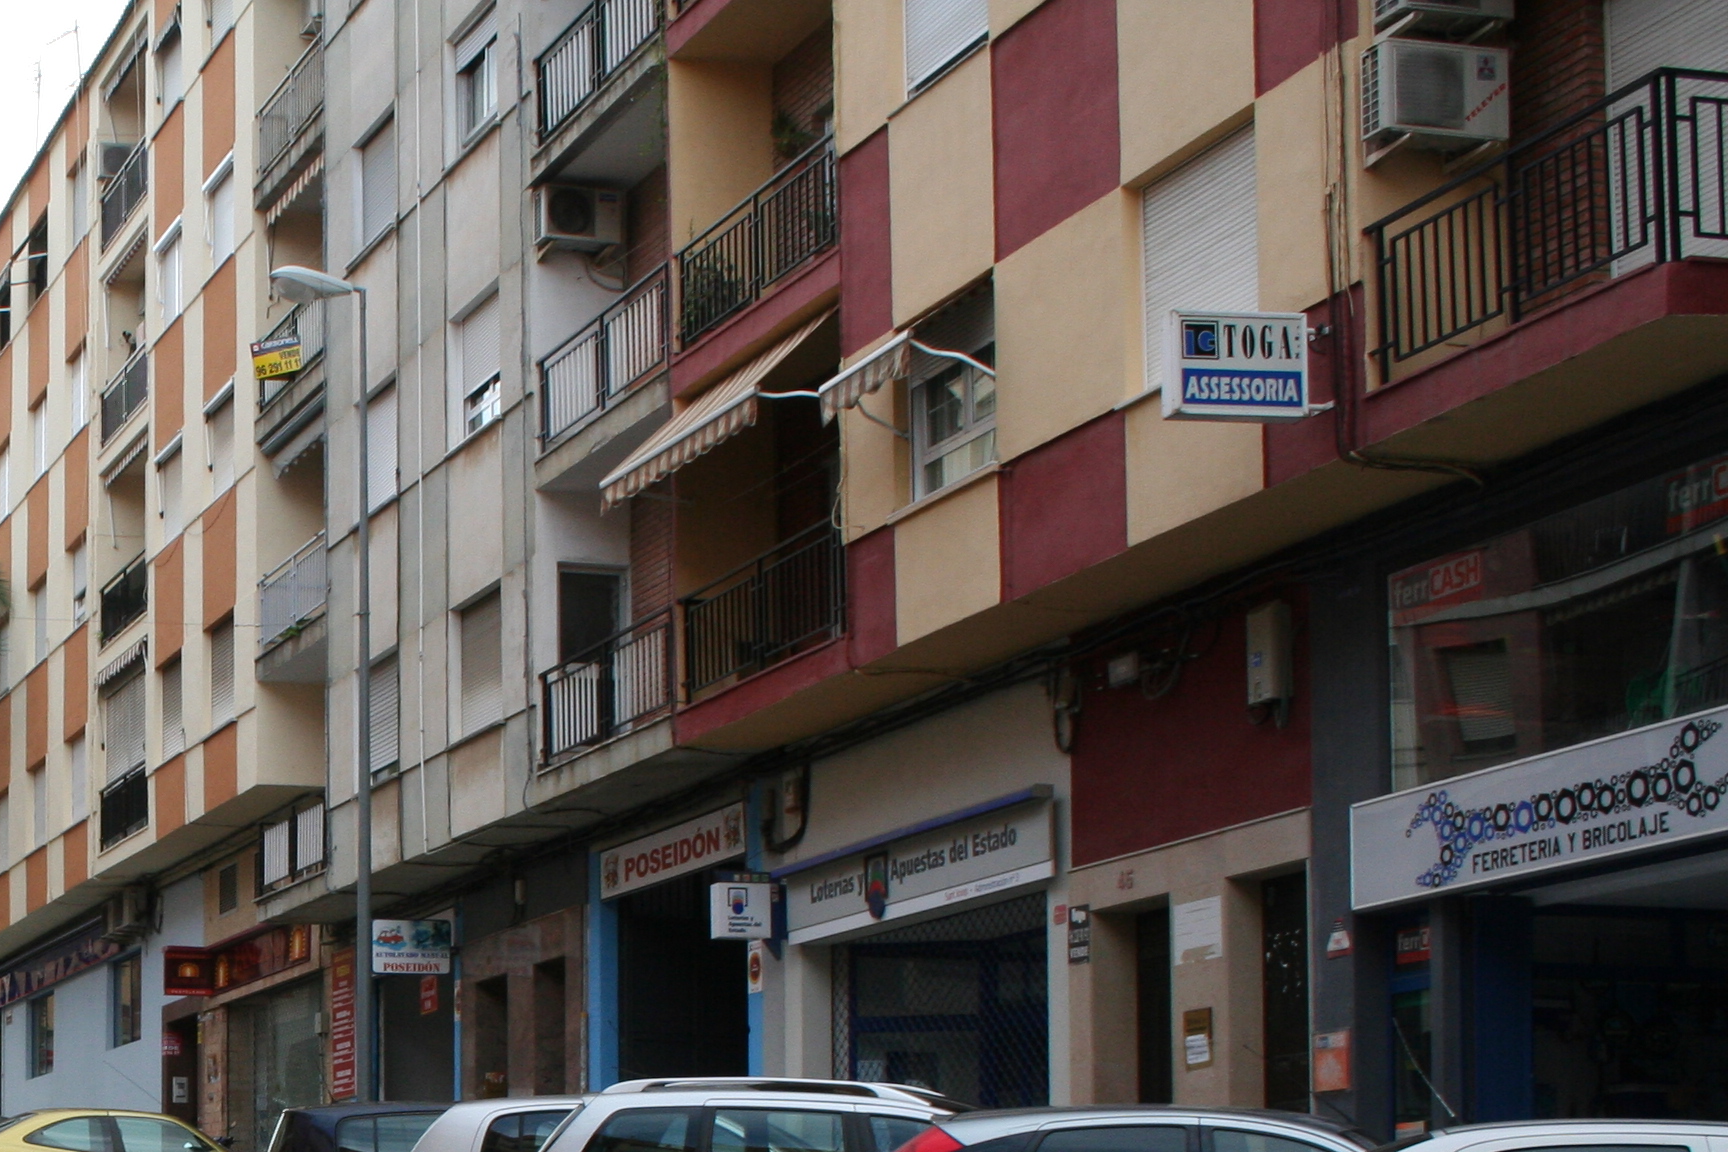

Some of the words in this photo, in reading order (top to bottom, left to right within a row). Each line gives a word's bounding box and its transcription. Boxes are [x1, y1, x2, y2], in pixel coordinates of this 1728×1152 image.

[1223, 324, 1292, 360] TOGA
[256, 364, 267, 377] 96
[1185, 376, 1299, 402] ASSESSORIA
[624, 827, 721, 882] POSEIDÓN
[890, 848, 946, 885] Apuestas
[949, 835, 969, 864] del
[972, 824, 1017, 857] Estado
[1472, 836, 1561, 874] FERRETERIA
[1567, 832, 1577, 853] Y
[1582, 811, 1670, 850] BRICOLAJE
[383, 961, 441, 972] POSEIDÓN
